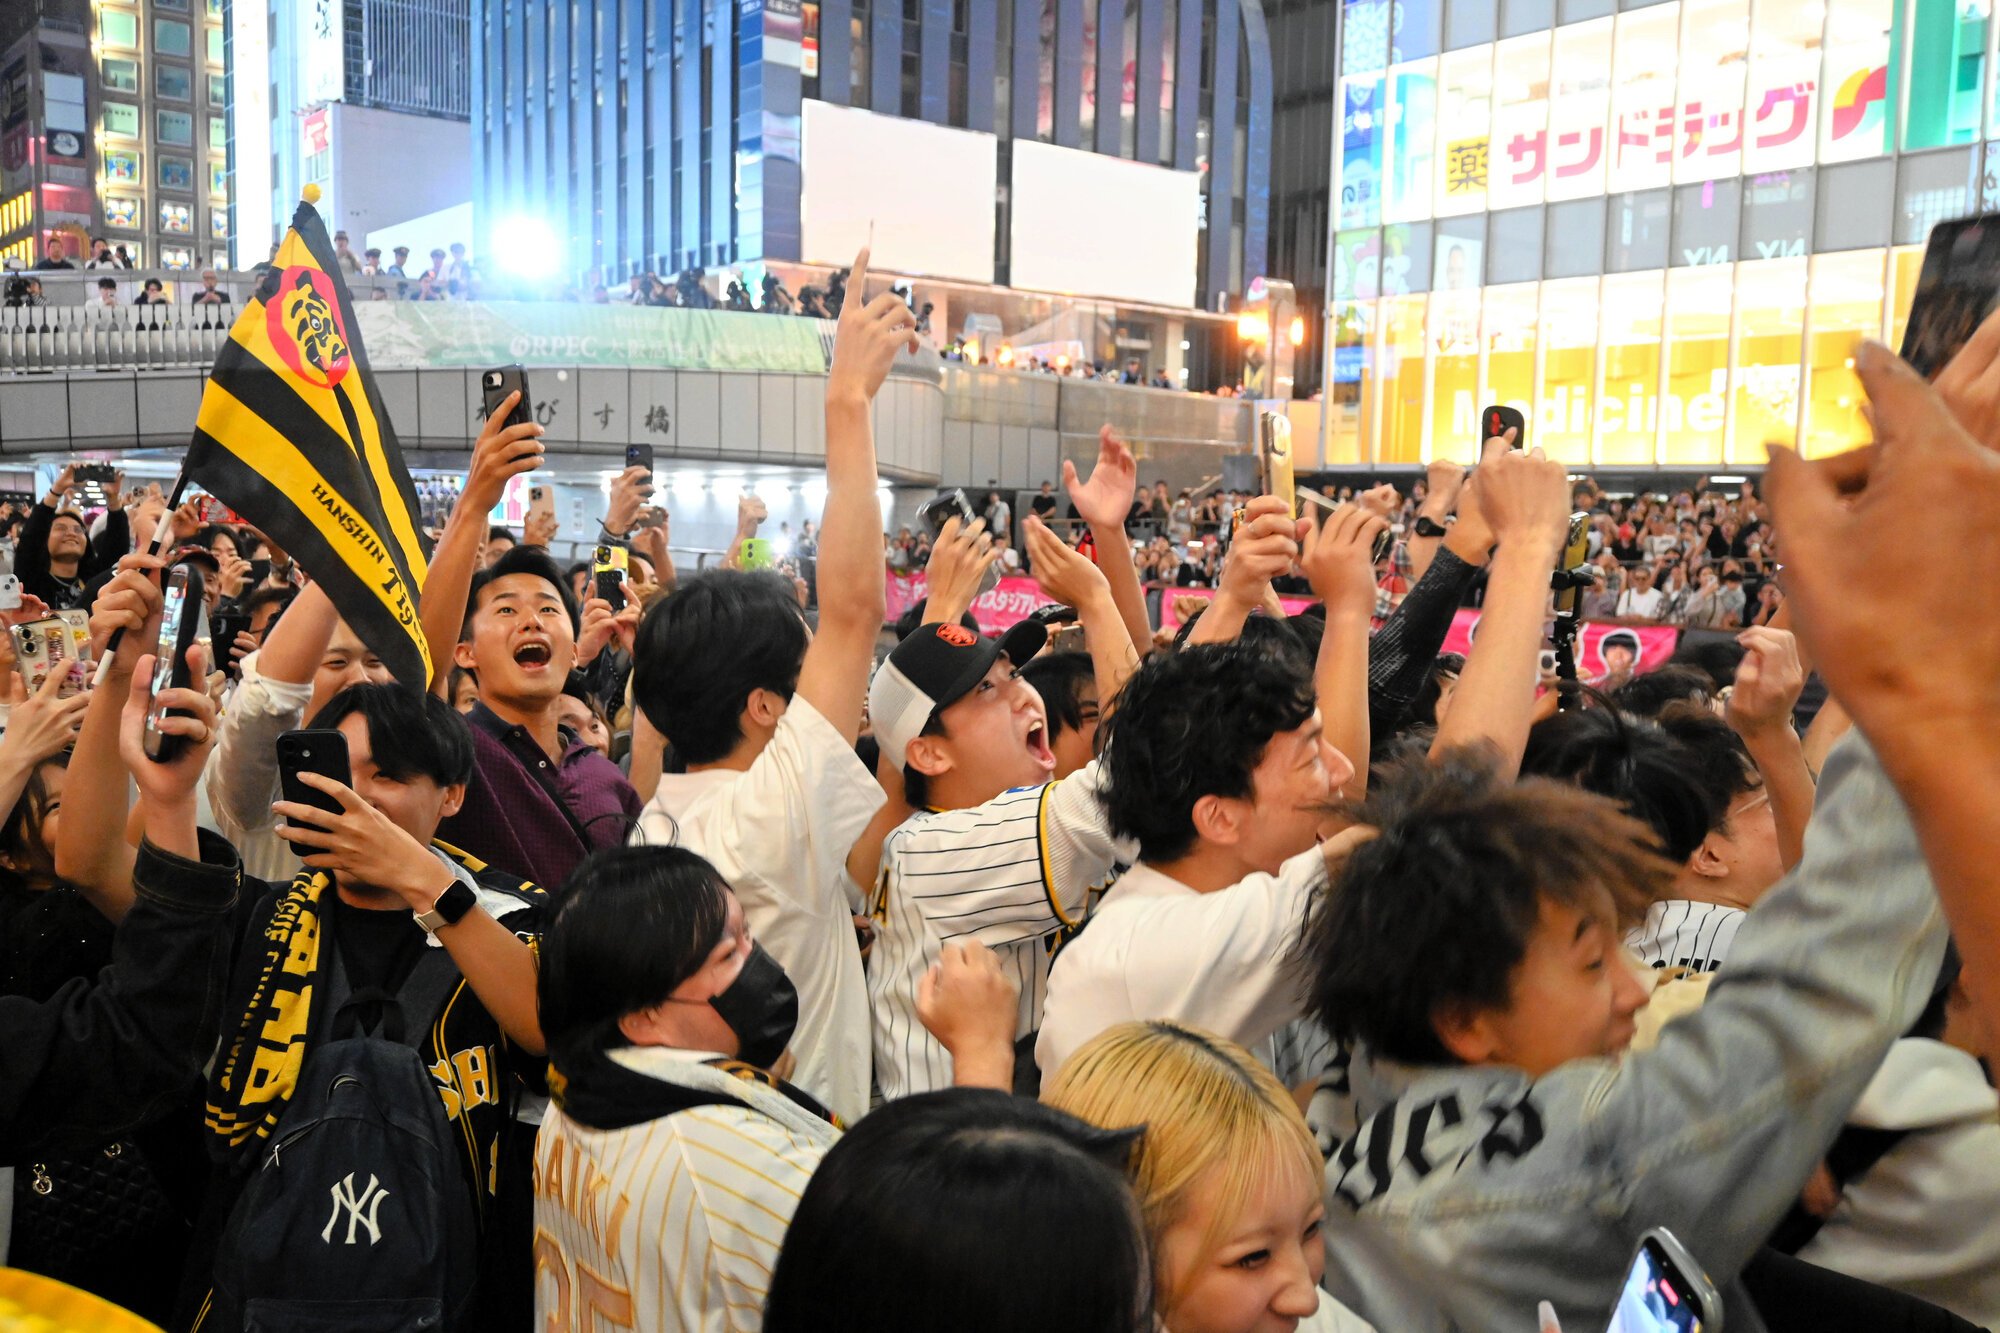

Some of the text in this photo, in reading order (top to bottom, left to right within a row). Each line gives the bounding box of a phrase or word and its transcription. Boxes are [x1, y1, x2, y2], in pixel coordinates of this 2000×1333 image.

[1507, 81, 1815, 185] サンドラッグ
[311, 483, 386, 564] HANSHIN
[321, 1171, 390, 1246] NY
